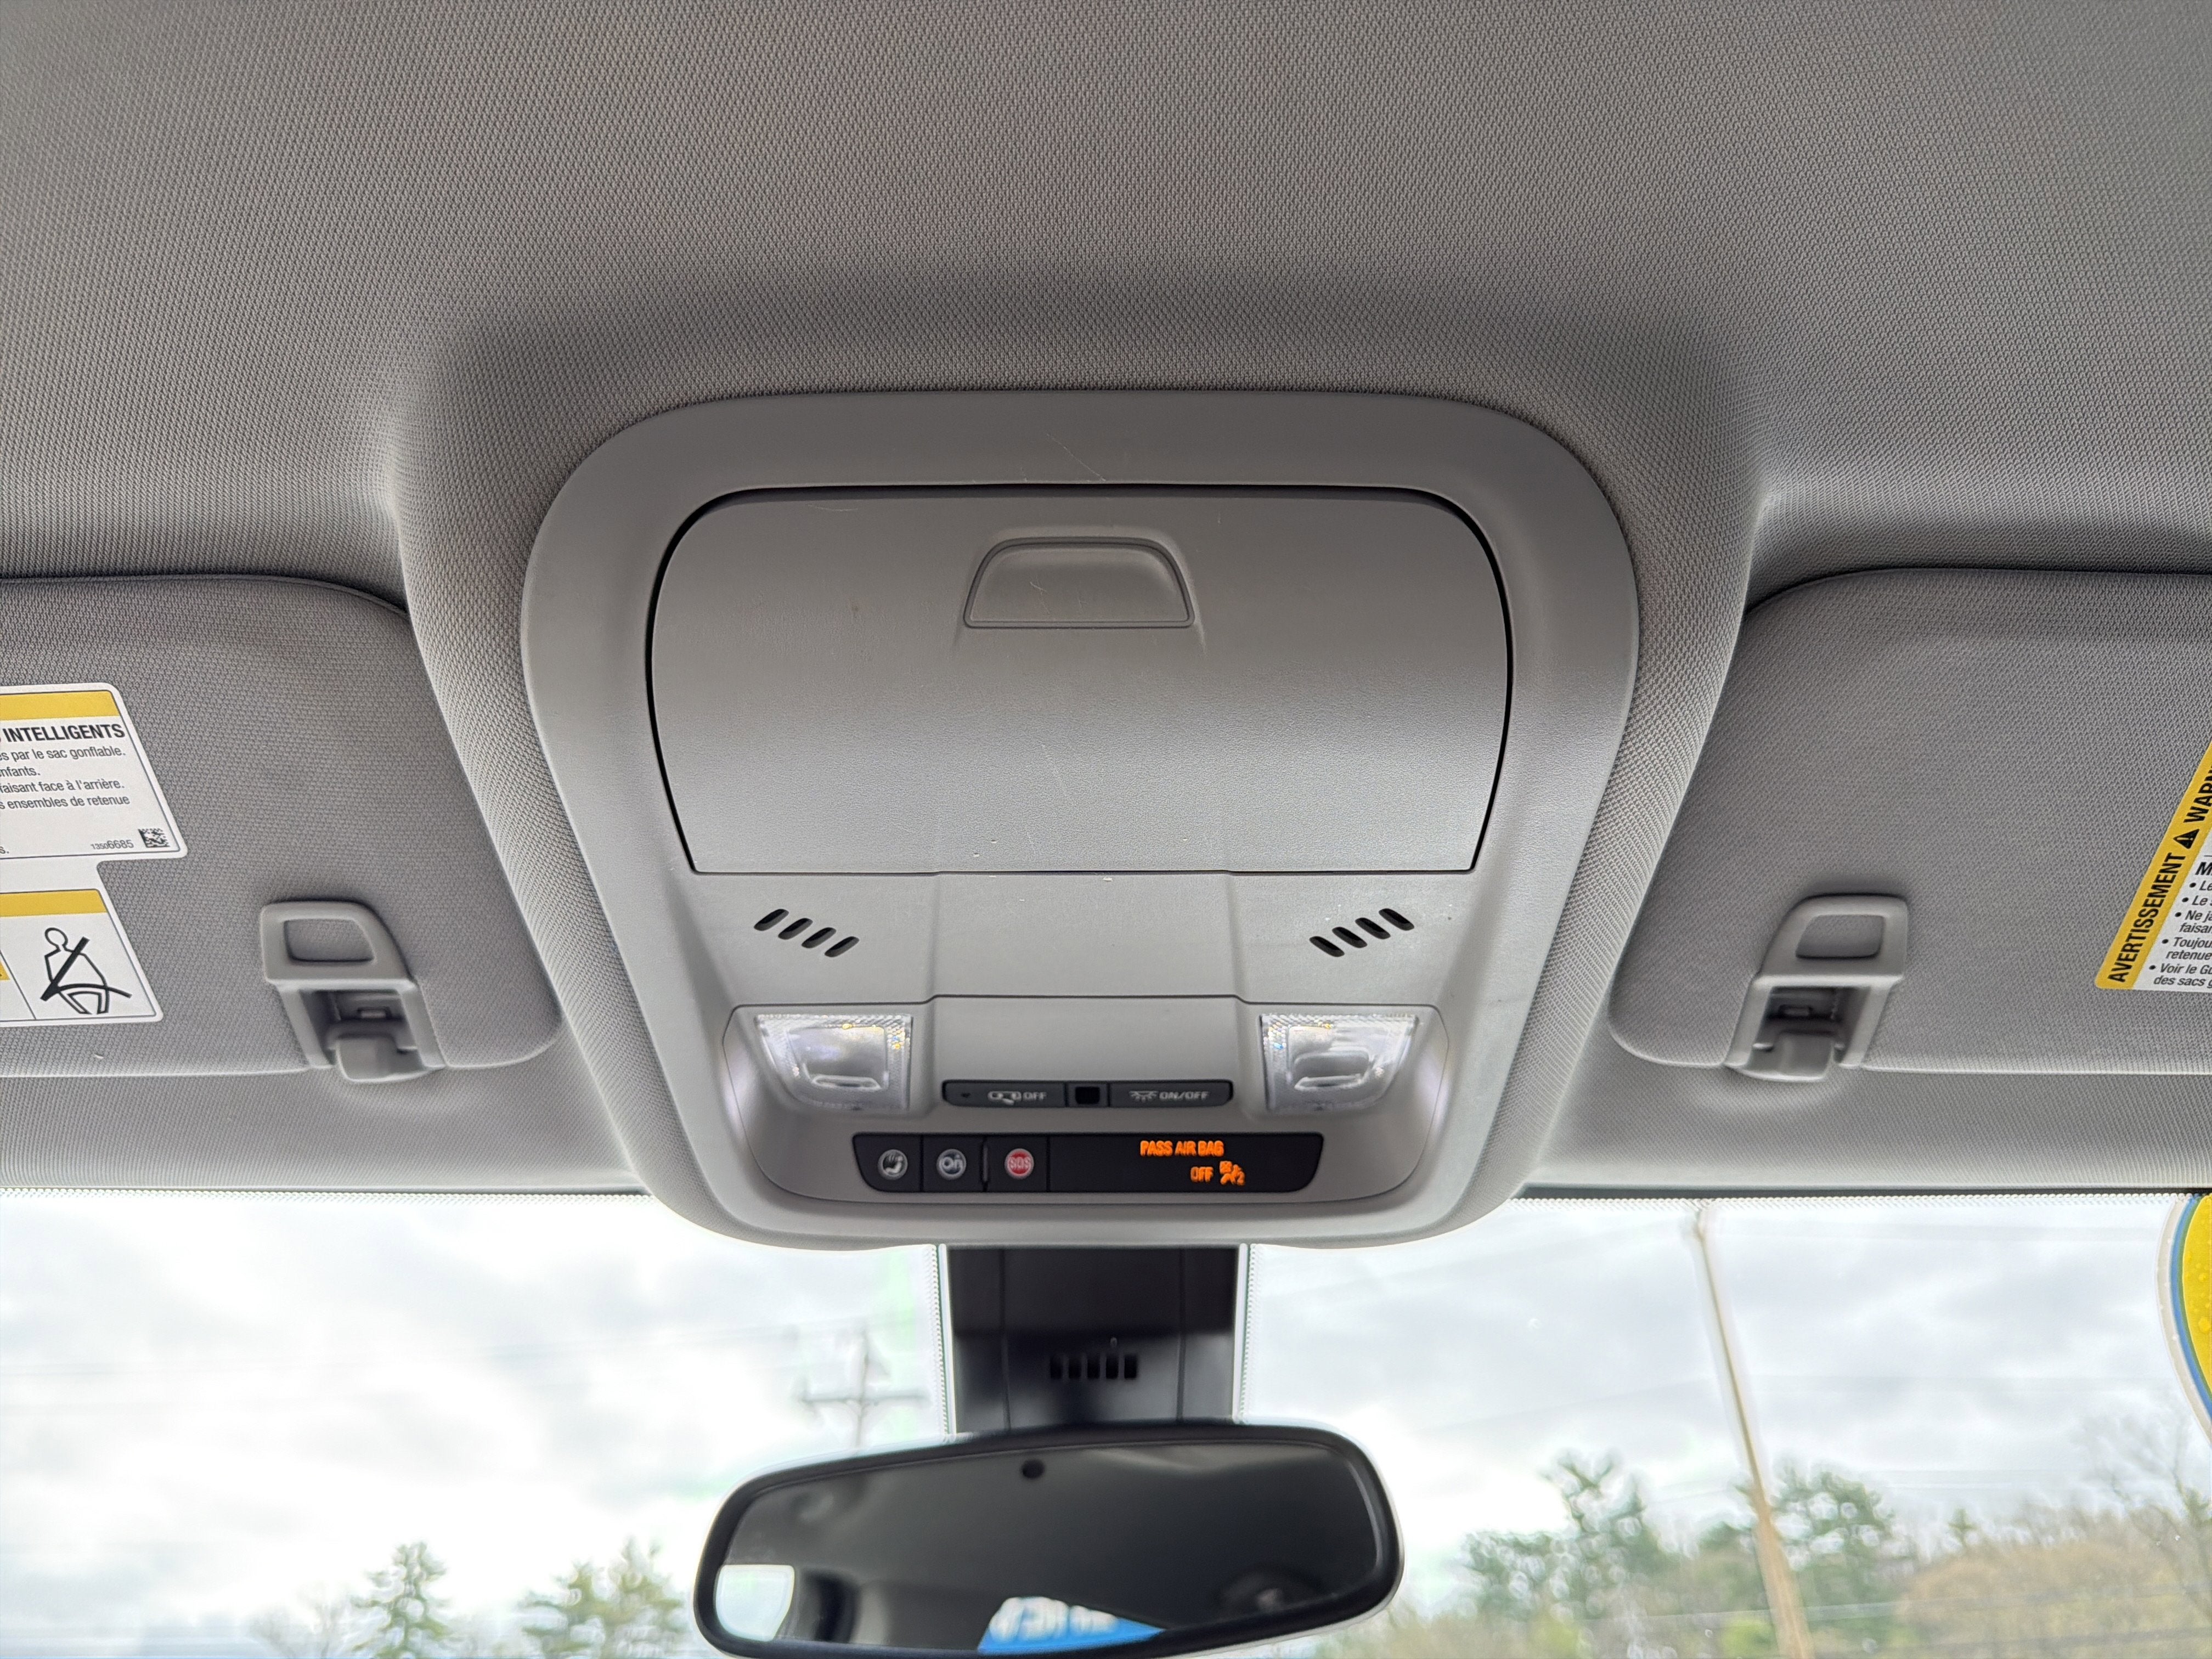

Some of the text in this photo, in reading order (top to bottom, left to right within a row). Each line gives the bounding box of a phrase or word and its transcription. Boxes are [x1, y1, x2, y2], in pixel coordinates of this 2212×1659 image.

[3, 724, 126, 742] INTELLIGENTS
[10, 751, 30, 762] par
[31, 749, 44, 759] le
[46, 749, 67, 759] sac
[70, 746, 126, 760] gonflable.
[0, 766, 41, 777] nfants.
[38, 781, 65, 792] face
[66, 780, 76, 791] à
[75, 778, 125, 790] l'arrière.
[7, 797, 68, 809] ensembles
[70, 796, 85, 806] de
[88, 795, 131, 805] retenue
[90, 839, 134, 850] 13506685
[2192, 895, 2208, 906] Le
[2107, 852, 2186, 983] AVERTISSEMENT
[2185, 910, 2203, 921] Ne
[2160, 963, 2185, 974] Voir
[2185, 964, 2197, 974] le
[2153, 975, 2176, 985] des
[2177, 978, 2207, 987] sacs
[1023, 1091, 1047, 1101] OFF
[1159, 1091, 1210, 1101] ON/OFF
[1140, 1140, 1224, 1156] PASS AIR BAG
[1008, 1156, 1030, 1170] SOS
[1190, 1166, 1214, 1182] OFF
